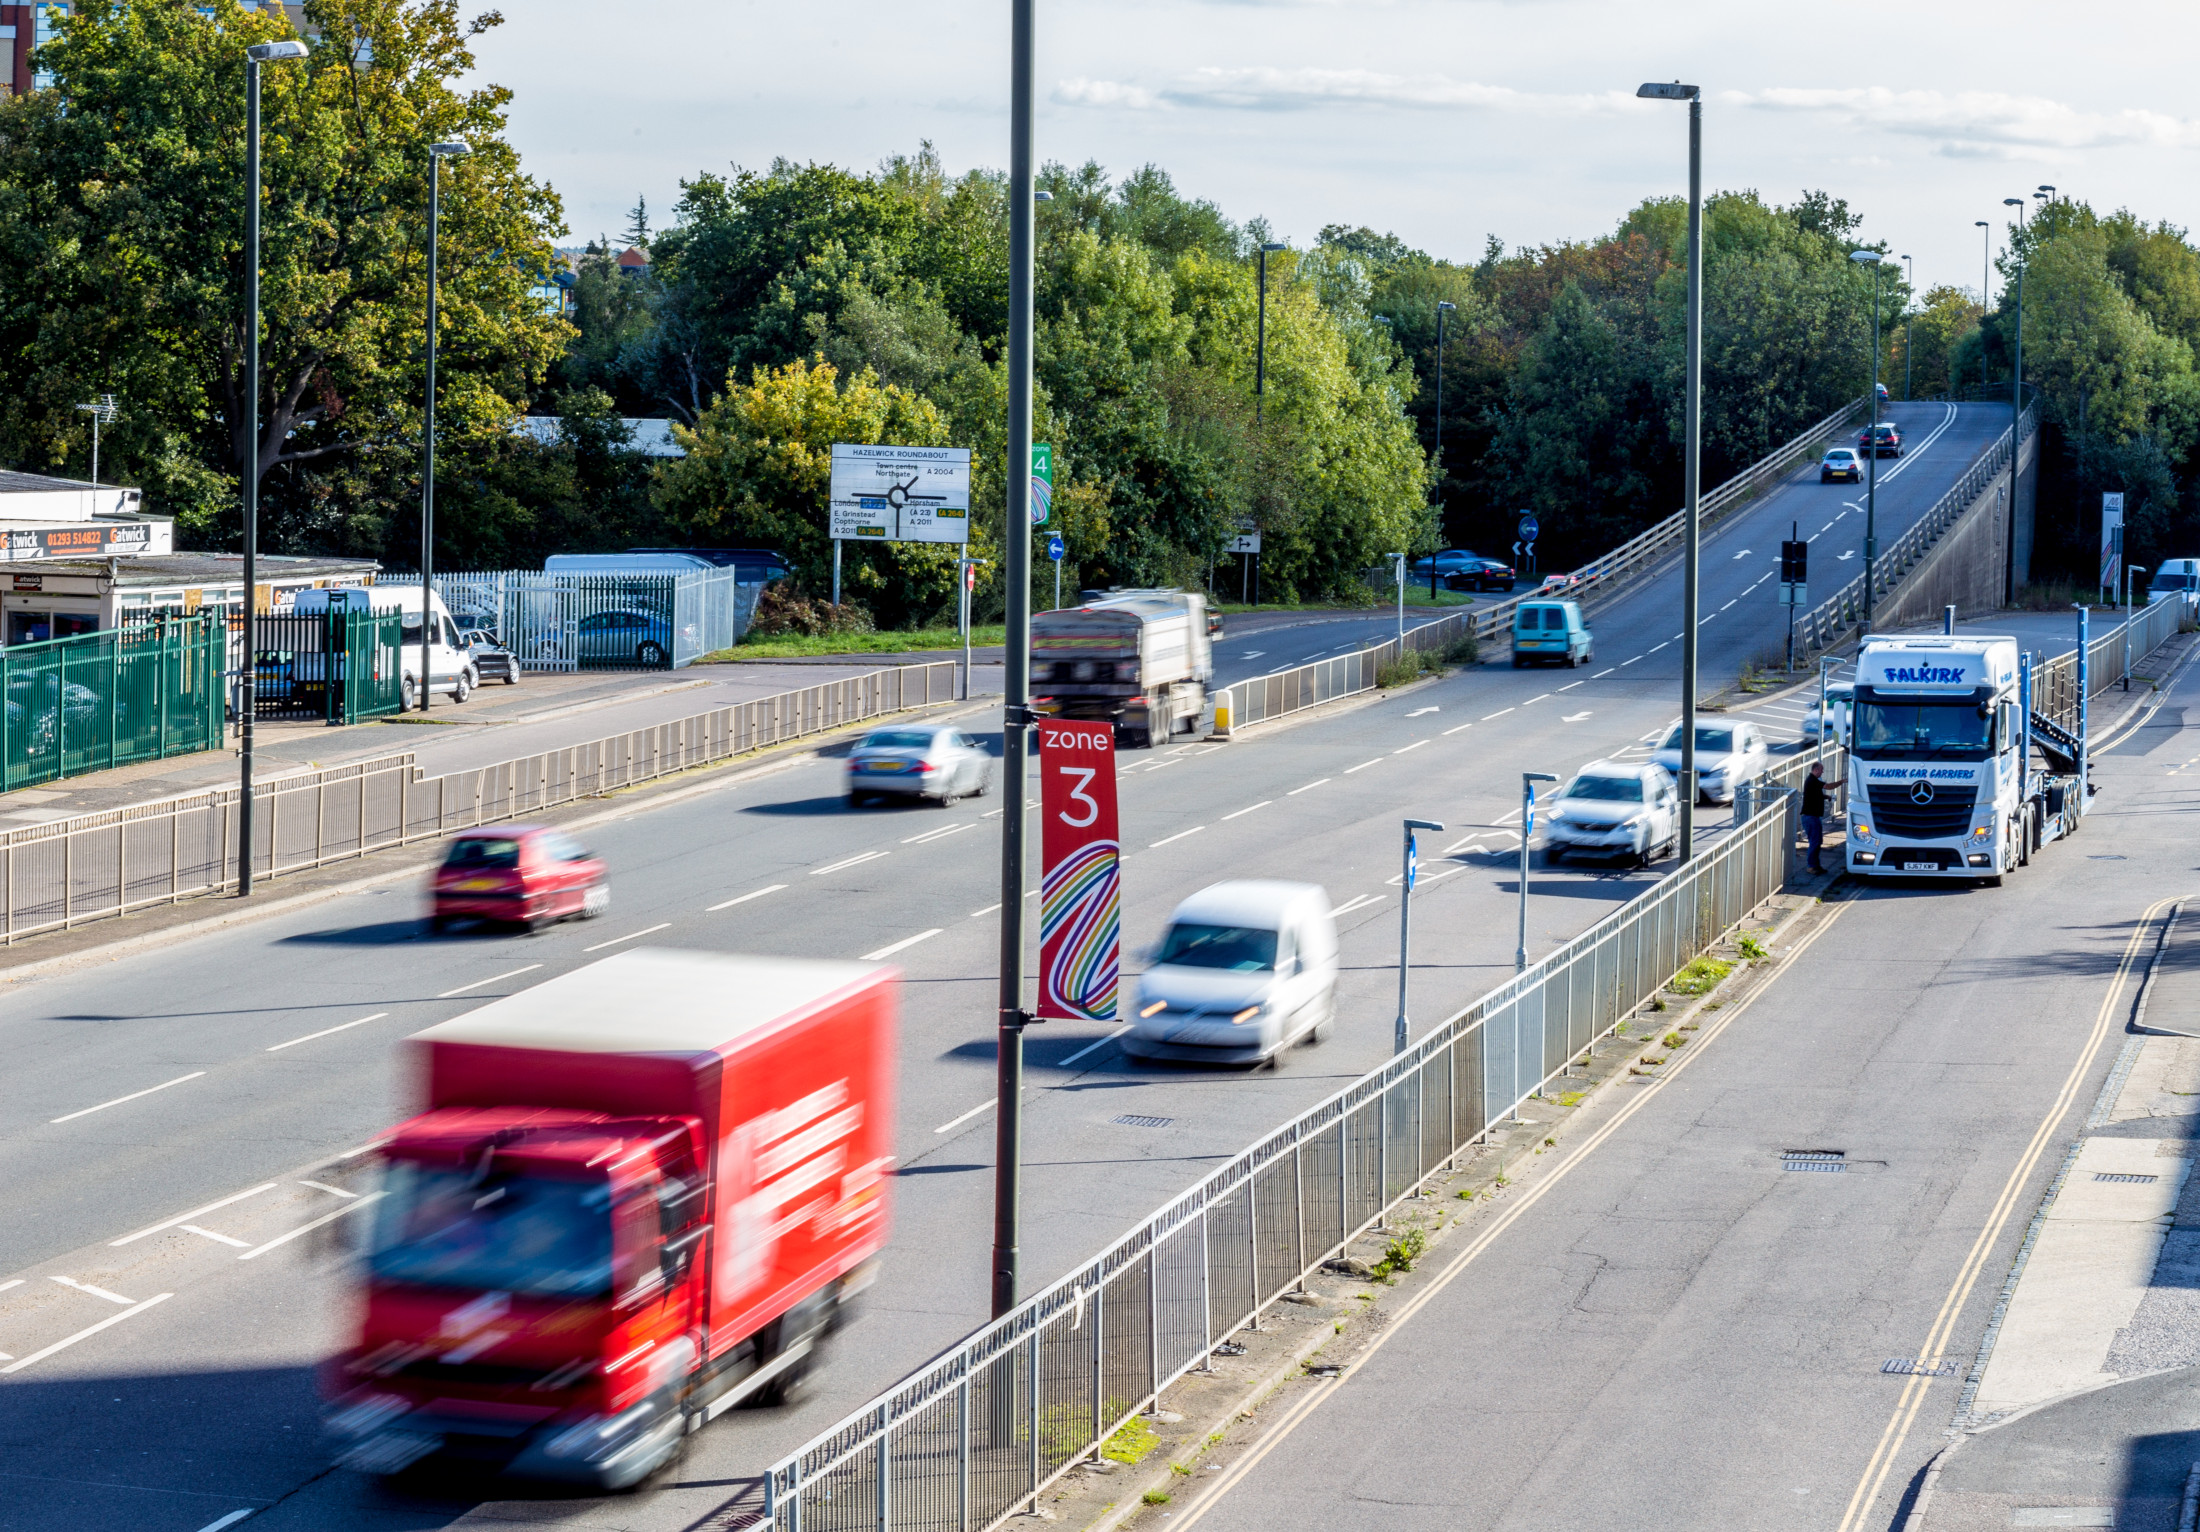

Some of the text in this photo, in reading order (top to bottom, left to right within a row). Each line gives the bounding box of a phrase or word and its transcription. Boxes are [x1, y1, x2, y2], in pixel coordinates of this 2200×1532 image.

[852, 449, 949, 459] HAZELWICK ROUNDABOUT
[1034, 455, 1048, 473] 4
[876, 470, 911, 478] Northgate
[910, 499, 941, 507] Horsham
[842, 510, 876, 518] Grinstead
[0, 531, 38, 549] Gatwick
[47, 531, 102, 546] 01293 514822
[110, 525, 146, 544] Gatwick
[1884, 667, 1966, 684] FALKIRK
[1045, 730, 1108, 751] zone
[1868, 768, 1976, 780] FALKIRK CAR CARRIERS
[1058, 766, 1099, 828] 3
